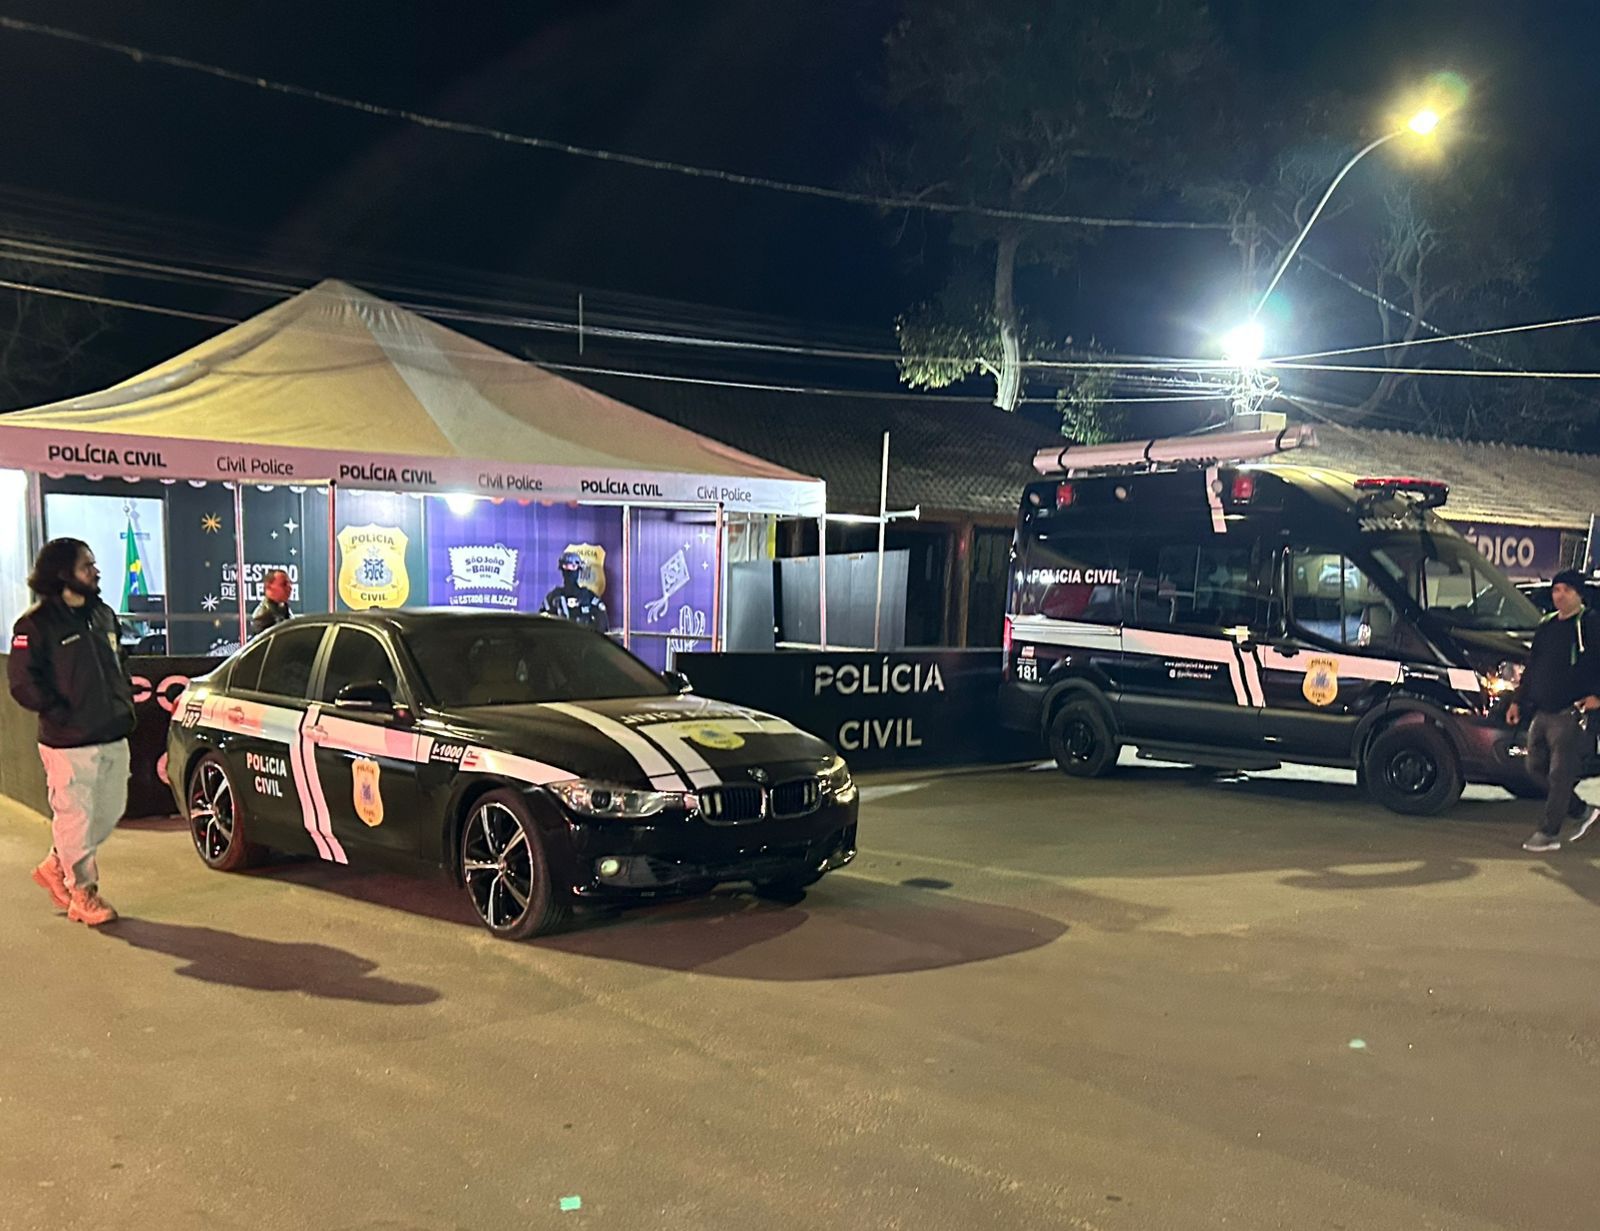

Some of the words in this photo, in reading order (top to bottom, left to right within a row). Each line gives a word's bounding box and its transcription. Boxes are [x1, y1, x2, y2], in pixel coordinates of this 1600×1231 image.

[48, 443, 119, 465] POLÍCIA
[124, 450, 167, 468] CIVIL
[216, 456, 247, 474] Civil
[251, 459, 294, 476] Police
[339, 462, 397, 482] POLÍCIA
[401, 469, 436, 485] CIVIL
[478, 472, 503, 489] Civil
[507, 474, 543, 491] Police
[581, 478, 630, 495] POLÍCIA
[633, 482, 662, 497] CIVIL
[697, 486, 718, 500] Civil
[721, 488, 751, 502] Police
[351, 534, 396, 546] POLÍCIA
[472, 565, 500, 575] BAHIA
[1084, 569, 1120, 584] CIVIL
[221, 586, 236, 597] DE
[360, 592, 388, 602] CIVIL
[814, 656, 944, 695] POLÍCIA
[1017, 664, 1037, 681] 181
[181, 710, 201, 728] 197
[839, 718, 922, 750] CIVIL
[246, 752, 287, 777] POLÍCIA
[254, 776, 283, 797] CIVIL
